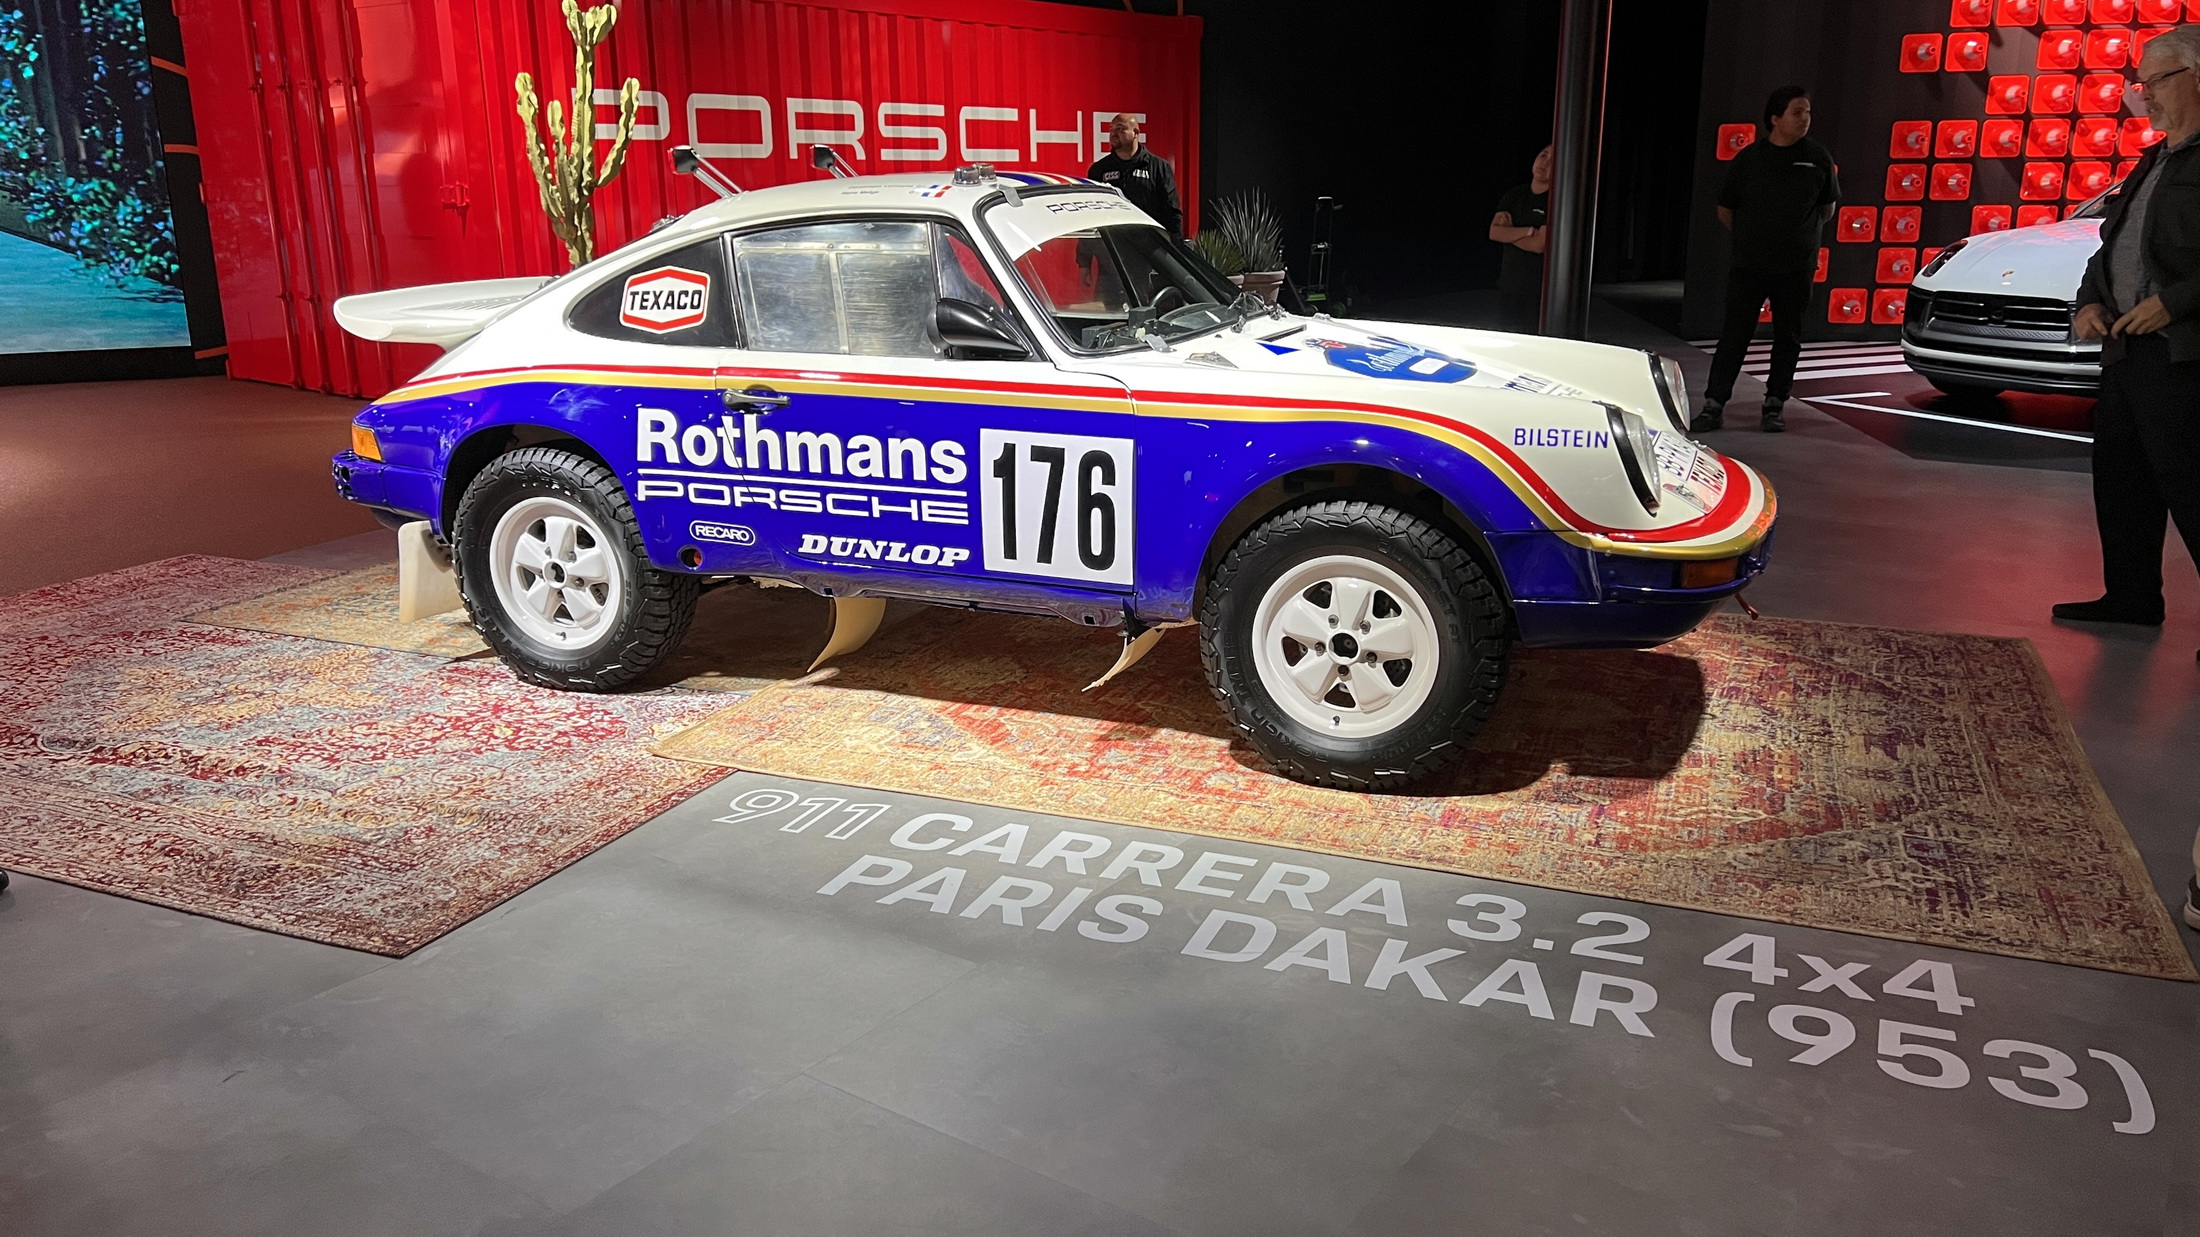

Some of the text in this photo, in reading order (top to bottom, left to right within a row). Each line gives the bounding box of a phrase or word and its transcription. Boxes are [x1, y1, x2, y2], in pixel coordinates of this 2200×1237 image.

[571, 87, 1147, 163] PORSCHE
[1046, 201, 1132, 214] PORSCHE
[629, 290, 703, 311] TEXACO
[636, 407, 968, 484] Rothmans
[1514, 428, 1609, 449] BILSTEIN
[637, 480, 969, 525] PORSCHE
[993, 442, 1116, 571] 176
[694, 524, 750, 542] RECARO
[797, 533, 971, 567] DUNLOP
[711, 788, 1976, 1016] 911 CARRERA 3.2 4x4
[816, 854, 2157, 1135] PARIS DAKAR (953)
